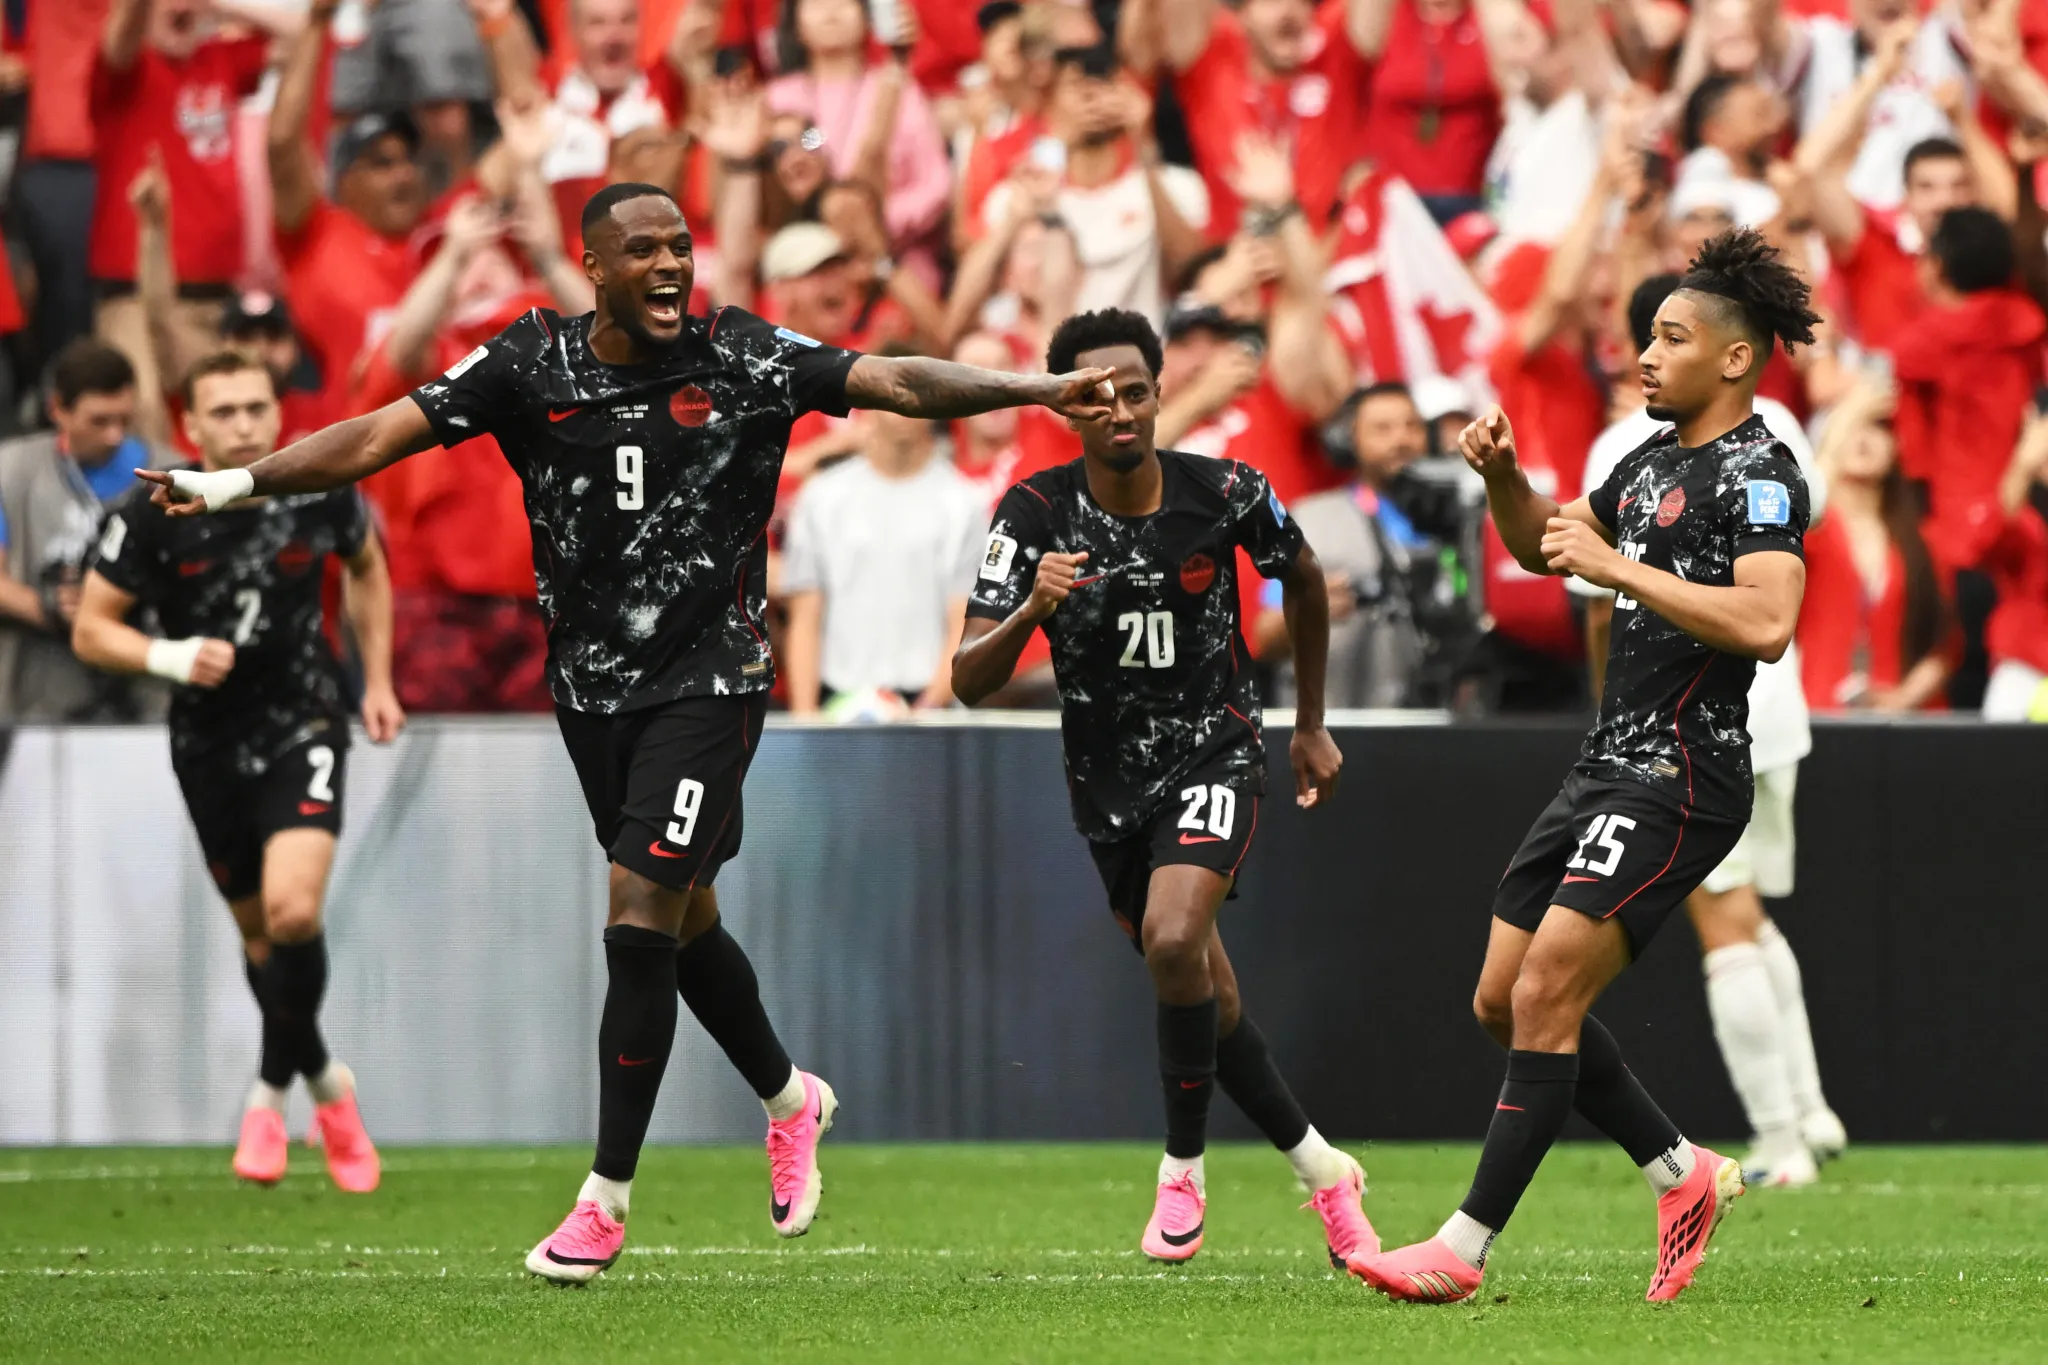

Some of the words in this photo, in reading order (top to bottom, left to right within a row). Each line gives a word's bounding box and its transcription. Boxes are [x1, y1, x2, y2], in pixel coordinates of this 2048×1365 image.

[616, 445, 644, 511] 9
[234, 588, 262, 647] 2
[1118, 610, 1175, 668] 20
[306, 745, 335, 802] 2
[665, 778, 705, 847] 9
[1177, 784, 1236, 841] 20
[1565, 813, 1637, 877] 25
